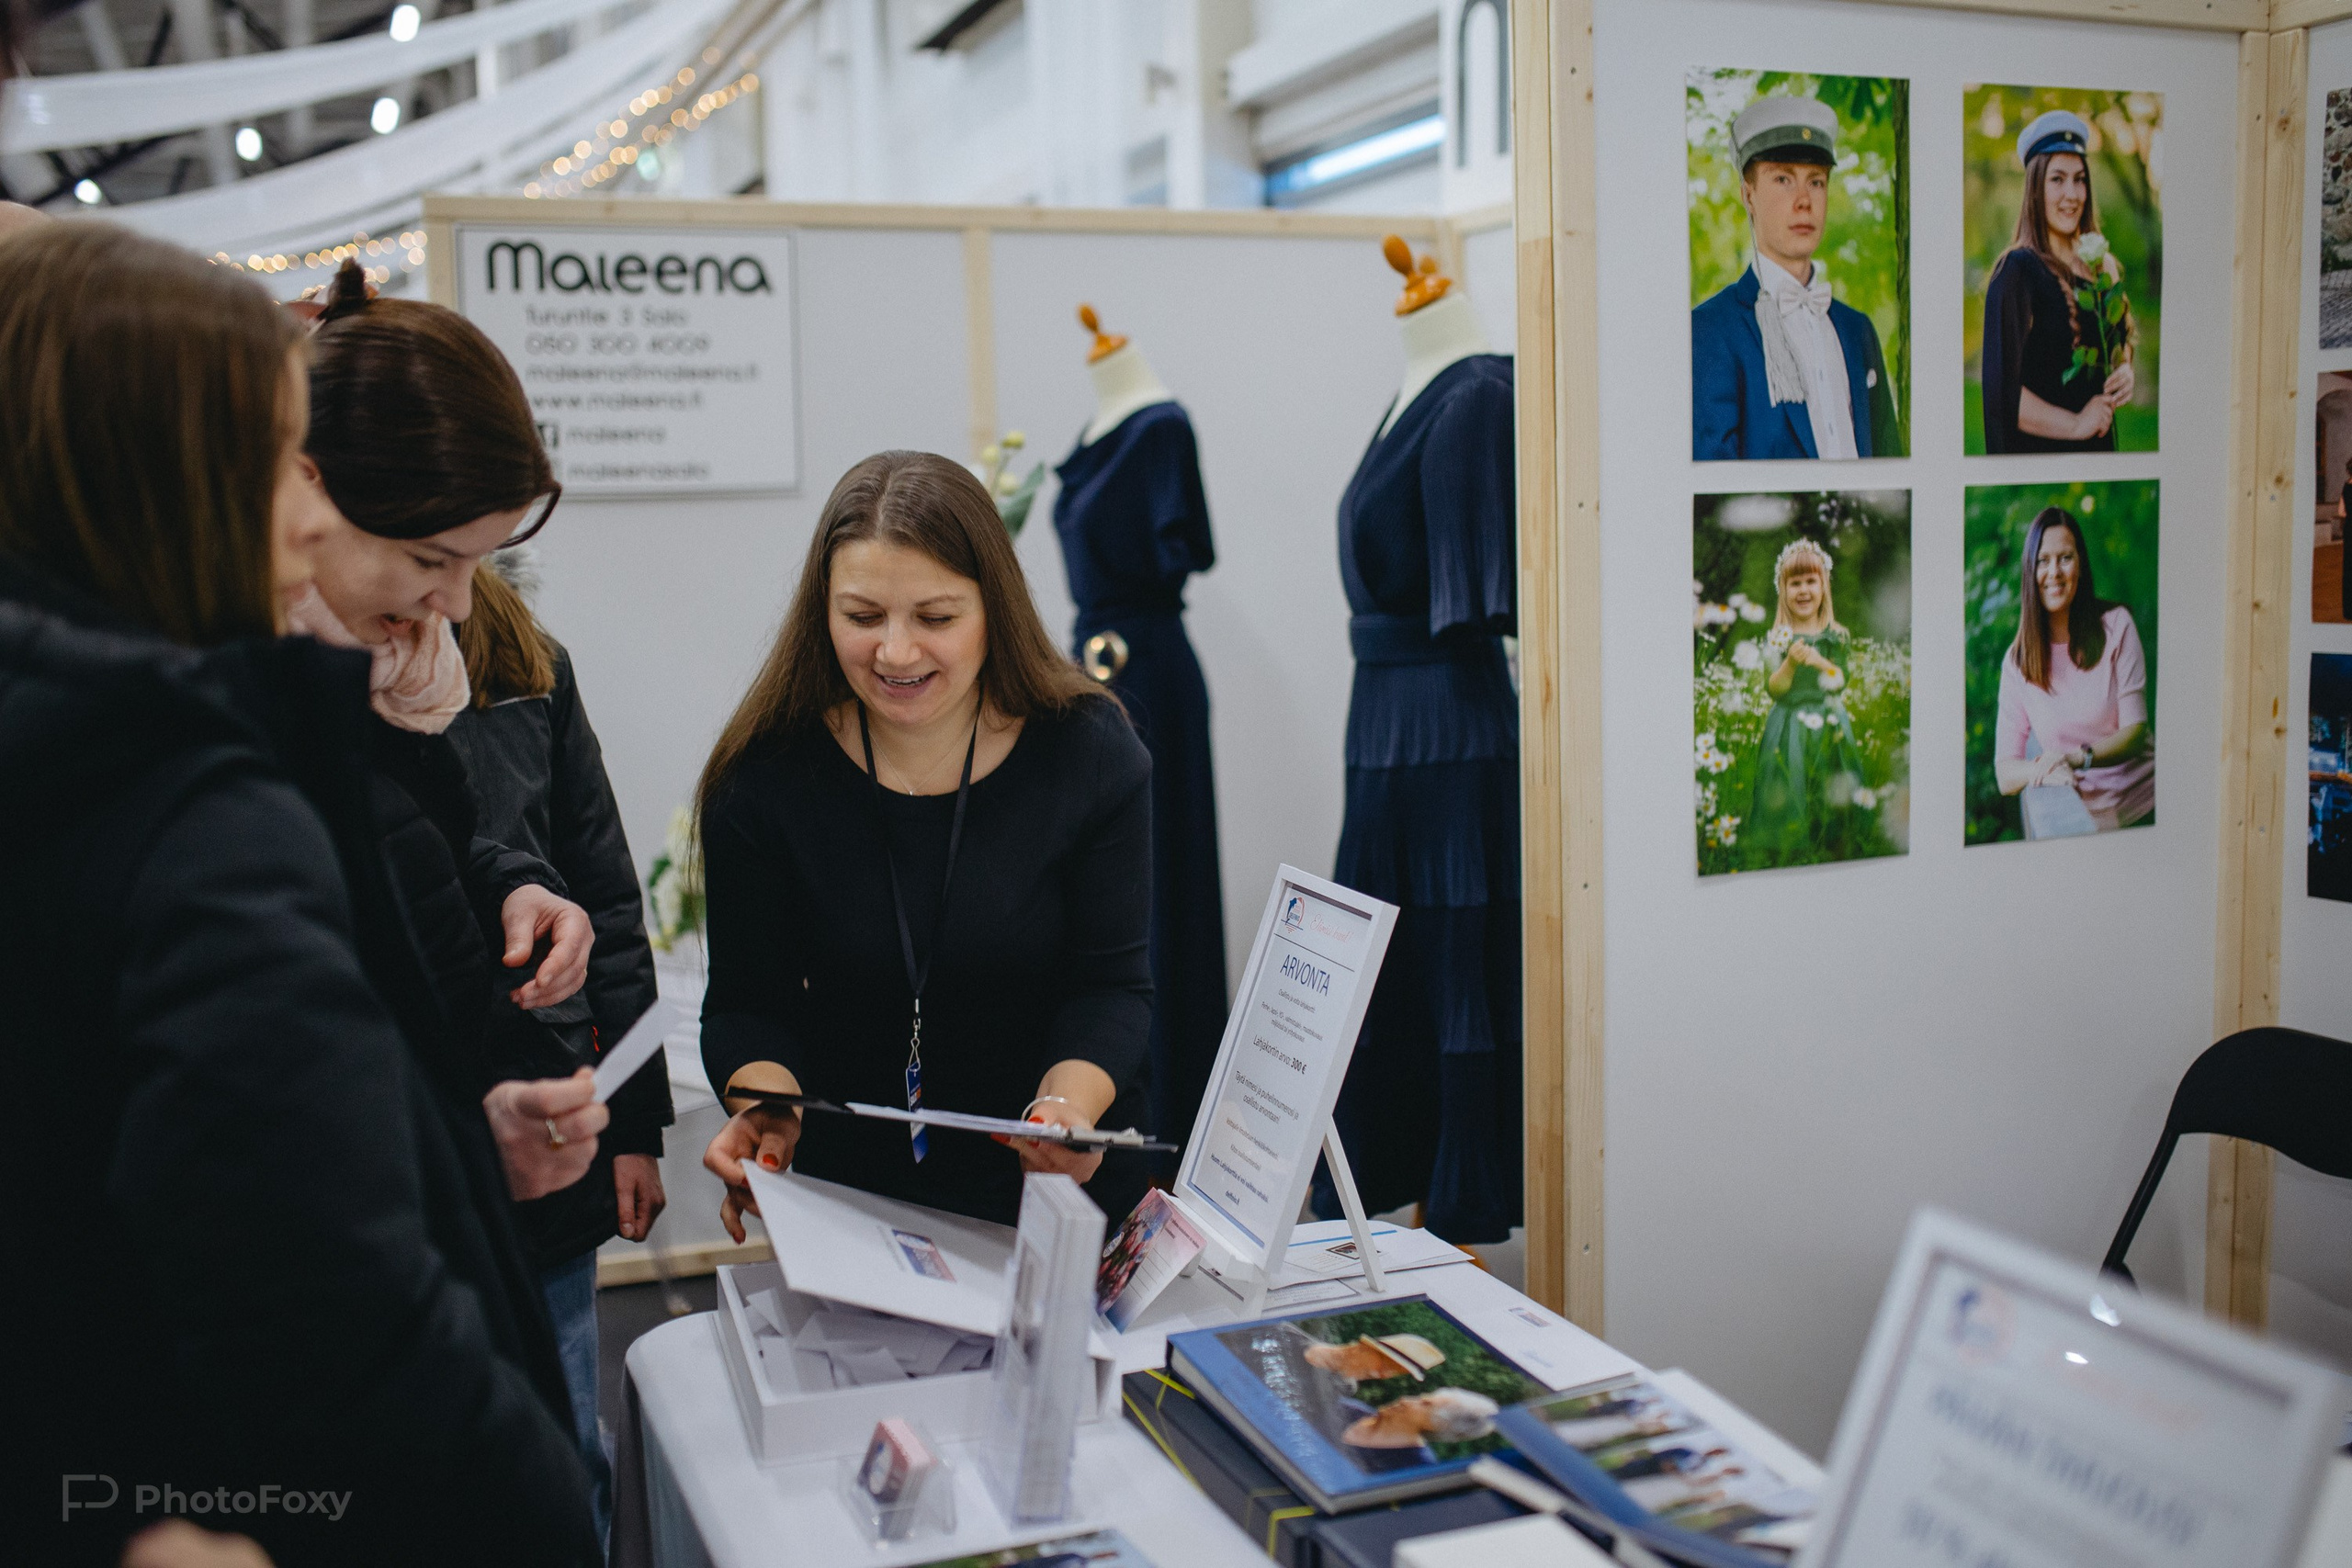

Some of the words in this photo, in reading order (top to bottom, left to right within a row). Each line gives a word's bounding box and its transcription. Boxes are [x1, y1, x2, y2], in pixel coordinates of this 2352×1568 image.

[1279, 954, 1330, 997] ARVONTA
[1253, 1035, 1279, 1056] Lahjakortin
[1278, 1052, 1291, 1066] arvo:
[1290, 1057, 1302, 1071] 300
[1301, 1064, 1306, 1075] €
[1235, 1070, 1246, 1084] Täytä
[1244, 1078, 1258, 1092] nimesi
[1242, 1094, 1259, 1110] osallistu
